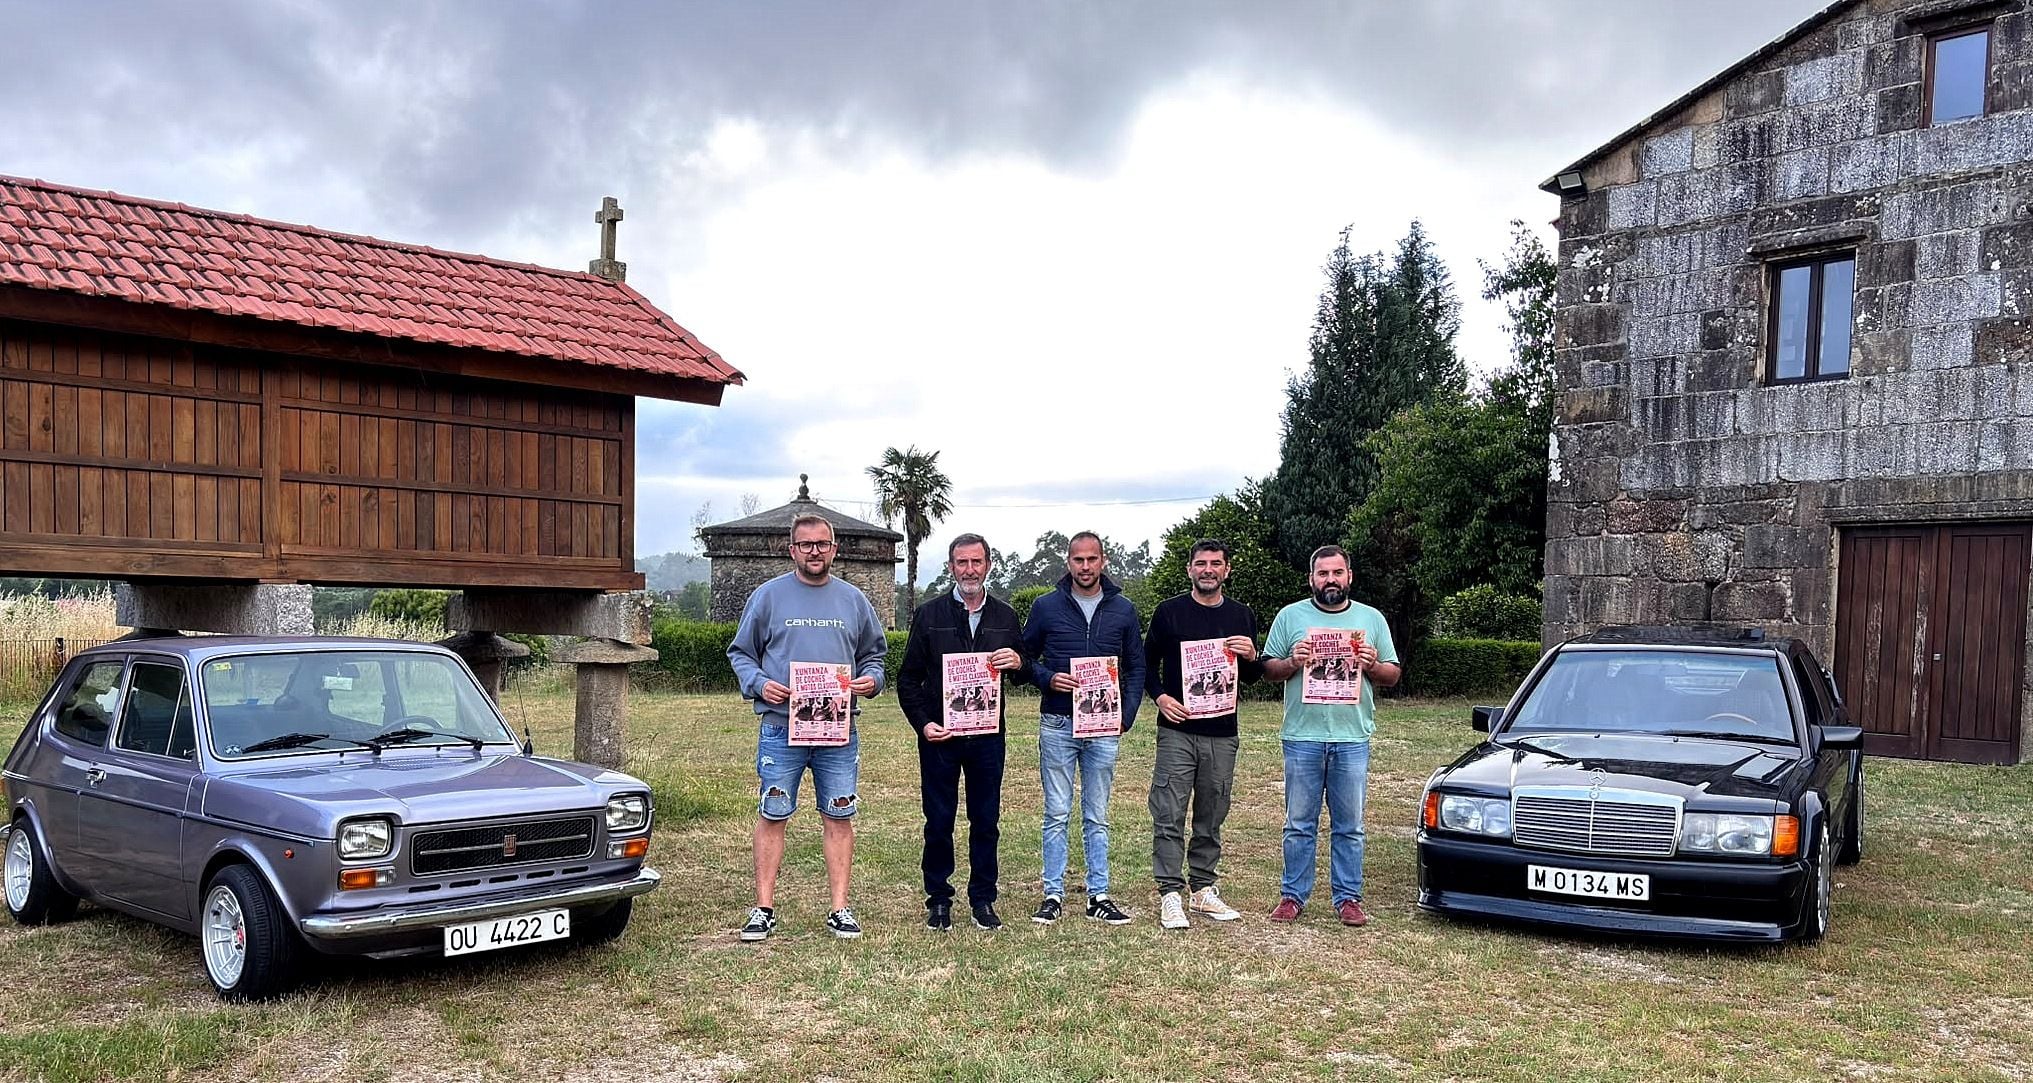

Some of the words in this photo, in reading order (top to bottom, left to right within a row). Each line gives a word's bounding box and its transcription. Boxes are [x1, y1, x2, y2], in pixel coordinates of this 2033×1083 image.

[1311, 633, 1342, 641] XUNTANZA
[1185, 642, 1216, 654] XUNTANZA
[947, 656, 979, 667] XUNTANZA
[1186, 654, 1192, 662] DE
[1194, 651, 1214, 660] COCHES
[795, 666, 828, 676] XUNTANZA
[956, 664, 976, 674] COCHES
[796, 676, 802, 684] DE
[804, 675, 826, 683] COCHES
[1534, 868, 1546, 888] M
[1554, 872, 1608, 894] 0134
[1617, 876, 1644, 896] MS
[450, 926, 477, 950] OU
[490, 917, 542, 944] 4422
[554, 914, 564, 934] C
